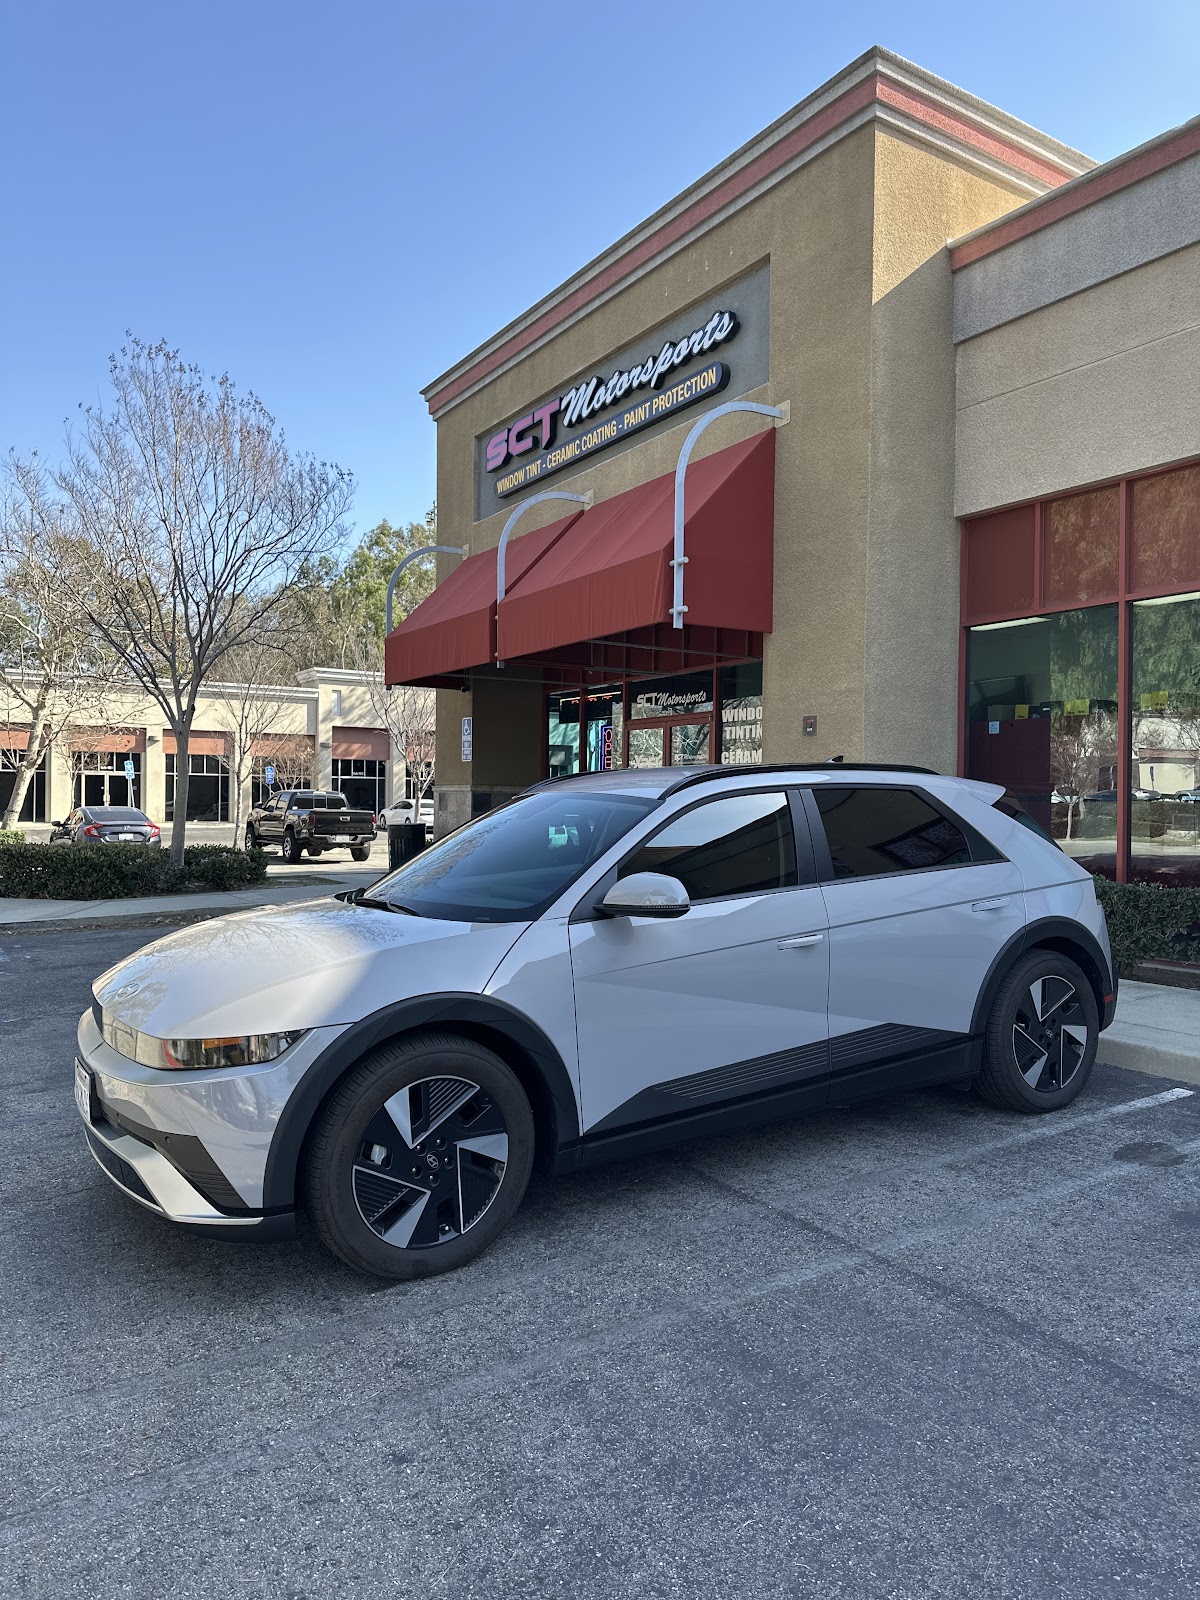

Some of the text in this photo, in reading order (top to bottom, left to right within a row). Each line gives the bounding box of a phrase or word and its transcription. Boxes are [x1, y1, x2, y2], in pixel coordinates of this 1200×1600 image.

[485, 310, 737, 474] SCT Motorsports
[496, 469, 525, 494] WINDOW
[525, 460, 542, 480] TINT
[546, 440, 580, 469] CERAMIC
[581, 421, 617, 451] COATING
[624, 402, 651, 429] PAINT
[652, 366, 717, 415] PROTECTION
[636, 690, 707, 708] SCT Motorsports
